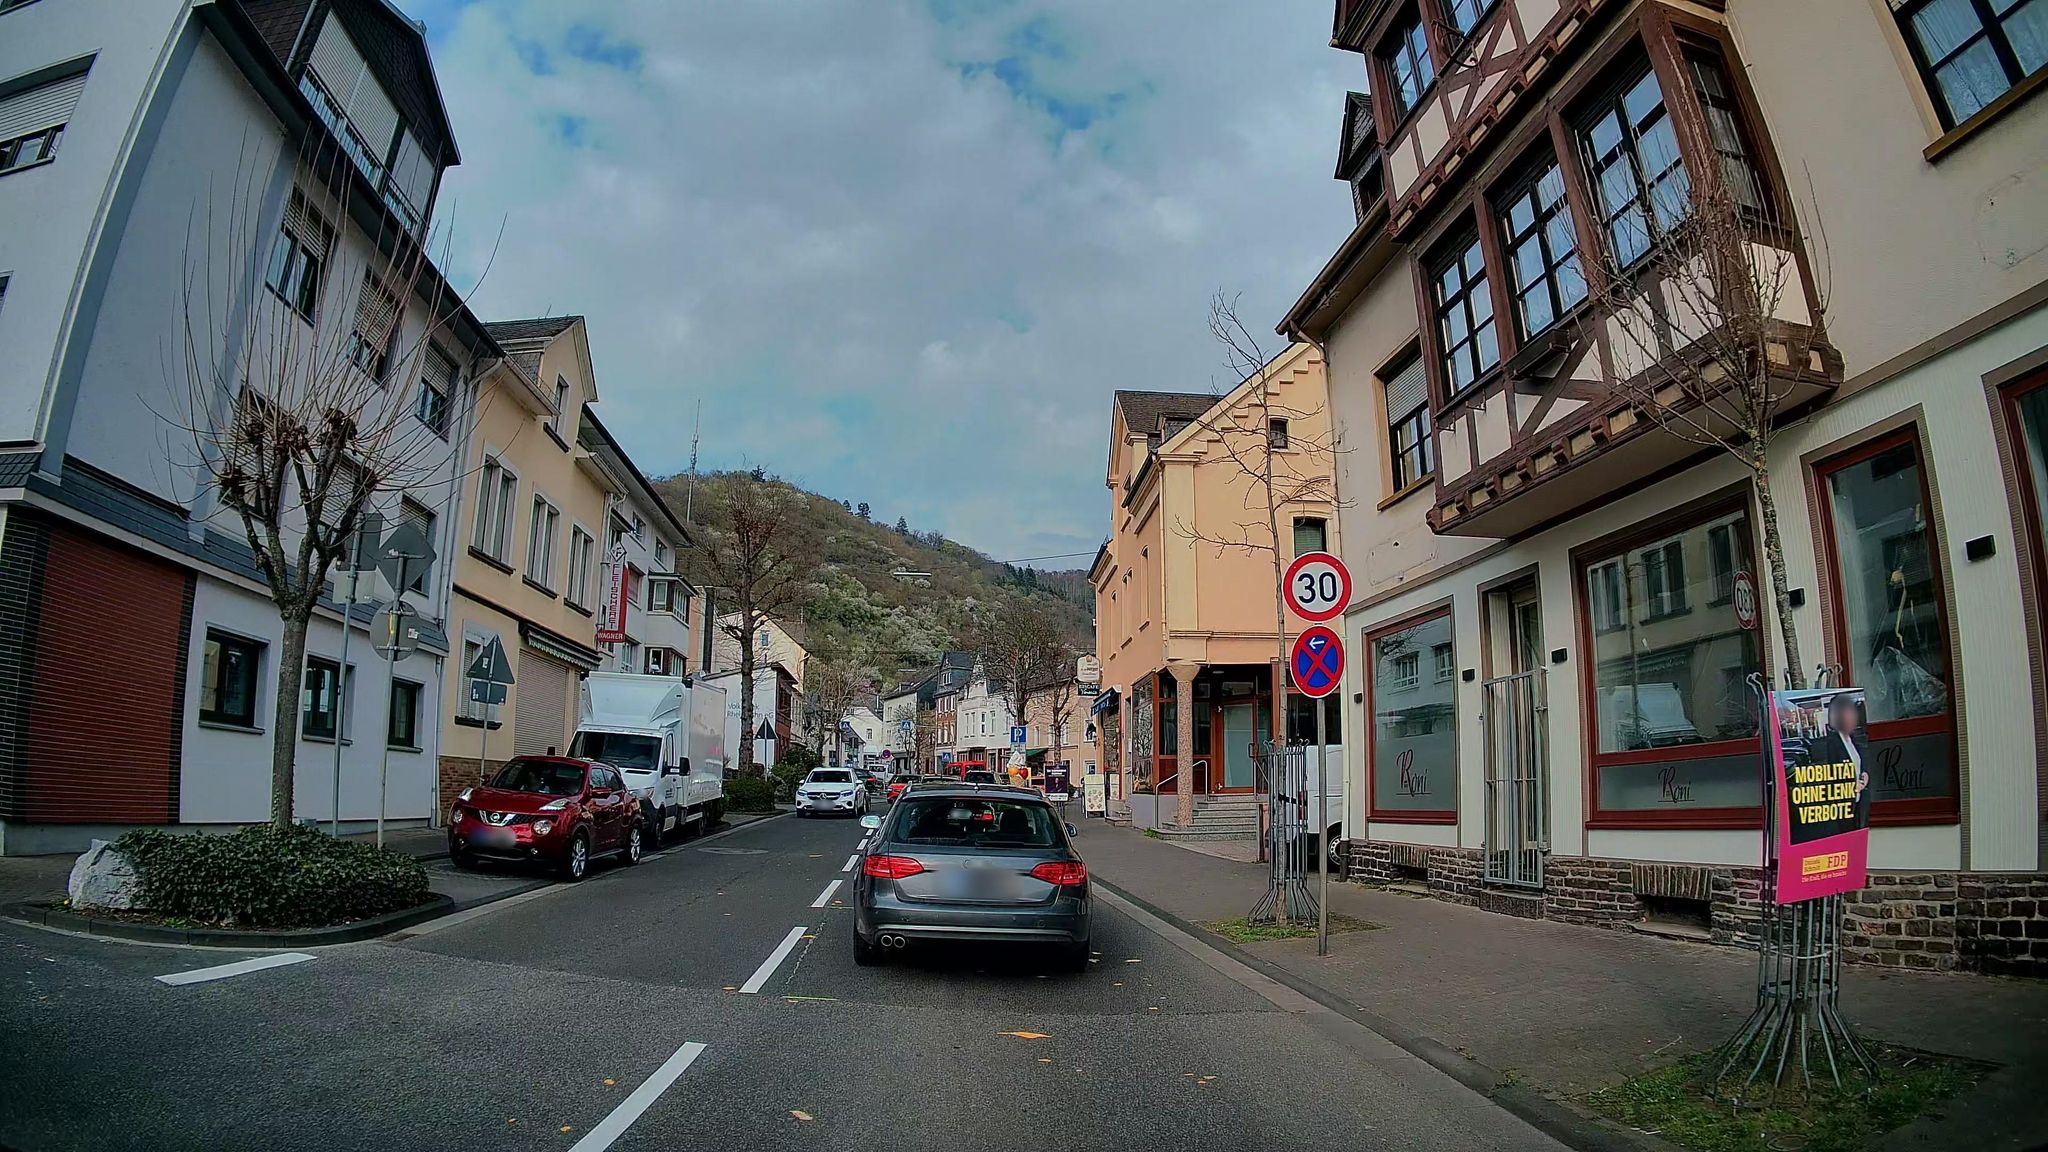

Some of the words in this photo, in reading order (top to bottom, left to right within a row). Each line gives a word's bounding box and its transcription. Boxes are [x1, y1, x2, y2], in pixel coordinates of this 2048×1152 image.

[609, 563, 620, 629] FLEISCHEREI
[1297, 571, 1338, 604] 30
[597, 631, 623, 641] WAGNER
[1013, 728, 1023, 742] P
[1396, 748, 1428, 797] Roni
[1795, 759, 1855, 783] MOBILITÄT
[1877, 745, 1924, 791] Roni
[1658, 766, 1692, 803] Roni
[1792, 784, 1826, 805] OHNE
[1799, 802, 1854, 824] VERBOTE.
[1827, 854, 1847, 869] FDP
